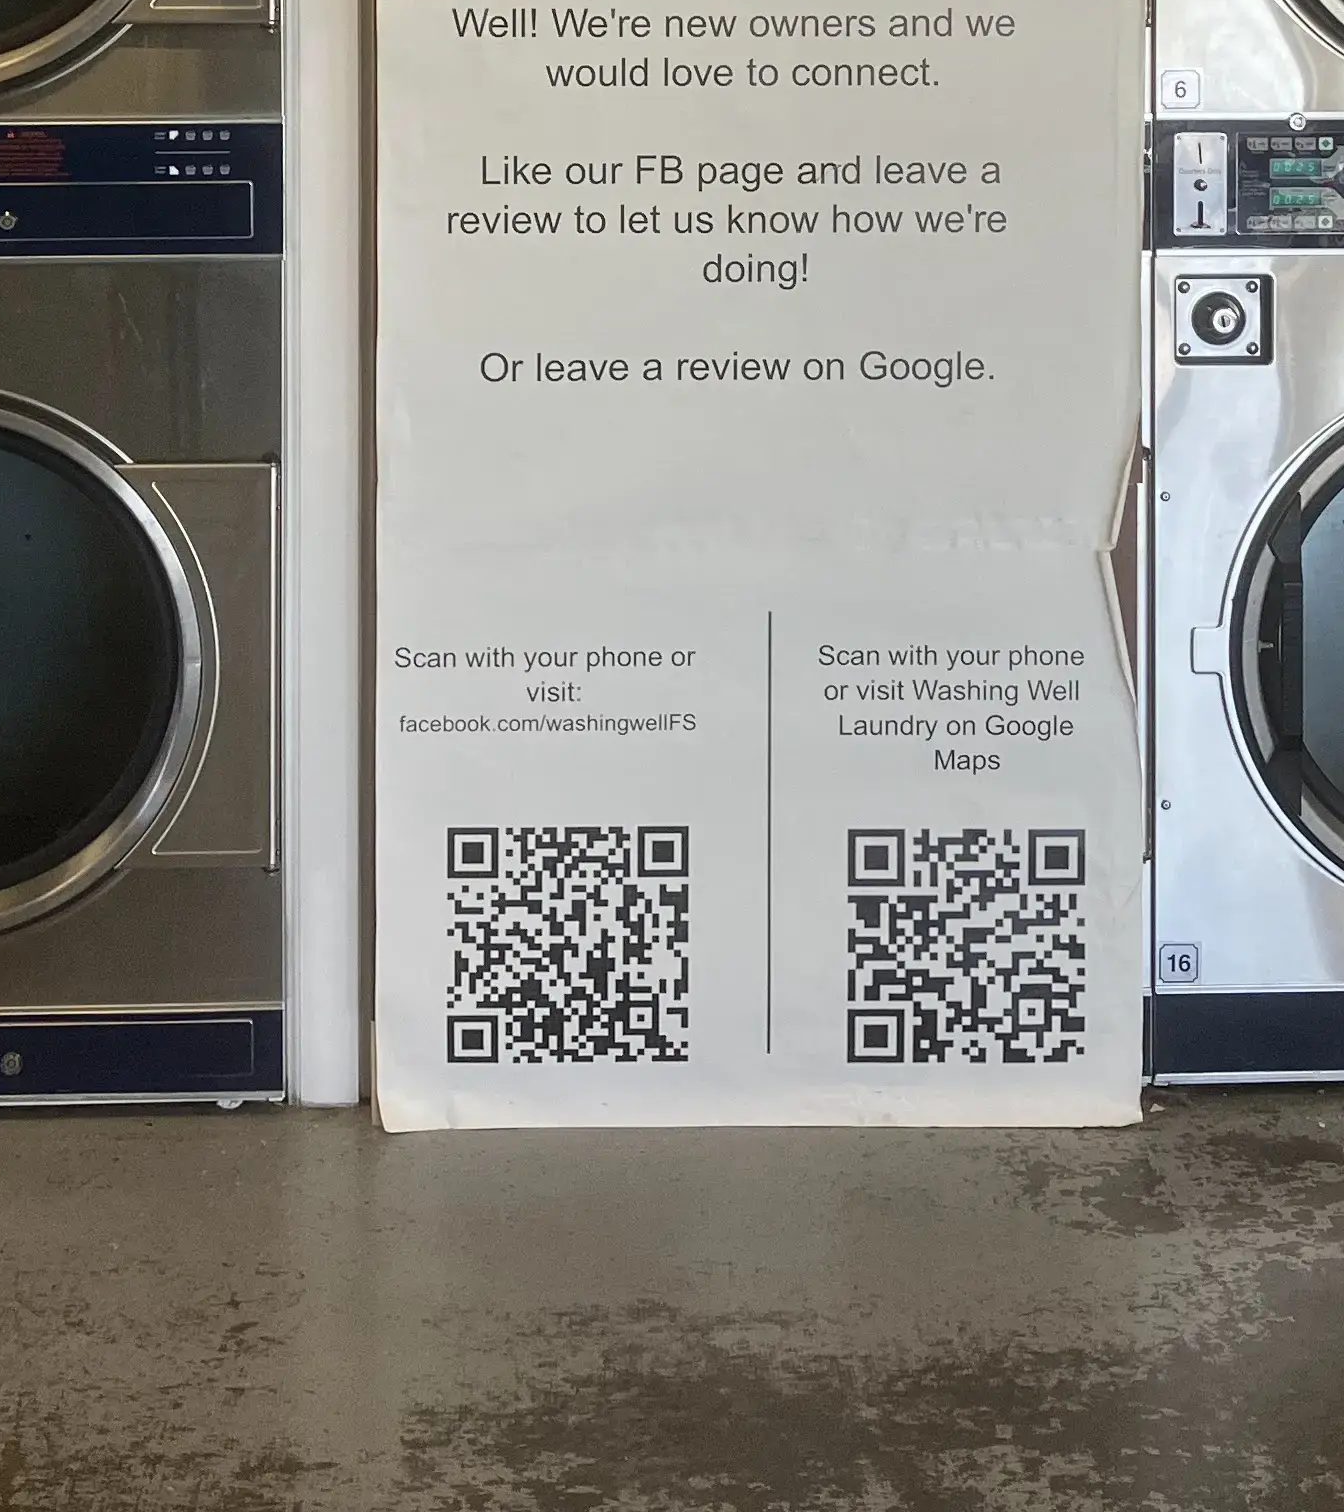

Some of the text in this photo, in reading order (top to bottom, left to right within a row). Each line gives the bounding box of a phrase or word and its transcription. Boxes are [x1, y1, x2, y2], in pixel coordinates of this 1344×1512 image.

[451, 7, 1016, 38] Well! We're new owners and we
[545, 56, 939, 87] would love to connect.
[1174, 80, 1188, 99] 6
[481, 154, 1001, 193] Like our FB page and leave a
[447, 203, 1007, 235] review to let us know how we're
[702, 252, 808, 291] doing!
[480, 350, 994, 389] Or leave a review on Google.
[394, 645, 697, 673] Scan with your phone or
[818, 644, 1085, 671] Scan with your phone
[526, 680, 582, 703] visit:
[824, 679, 1079, 706] or visit Washing Well
[399, 713, 697, 736] facebook.com/washingwellFS
[839, 714, 1074, 741] Laundry on Google
[934, 749, 1001, 775] Maps
[1167, 953, 1191, 973] 16
